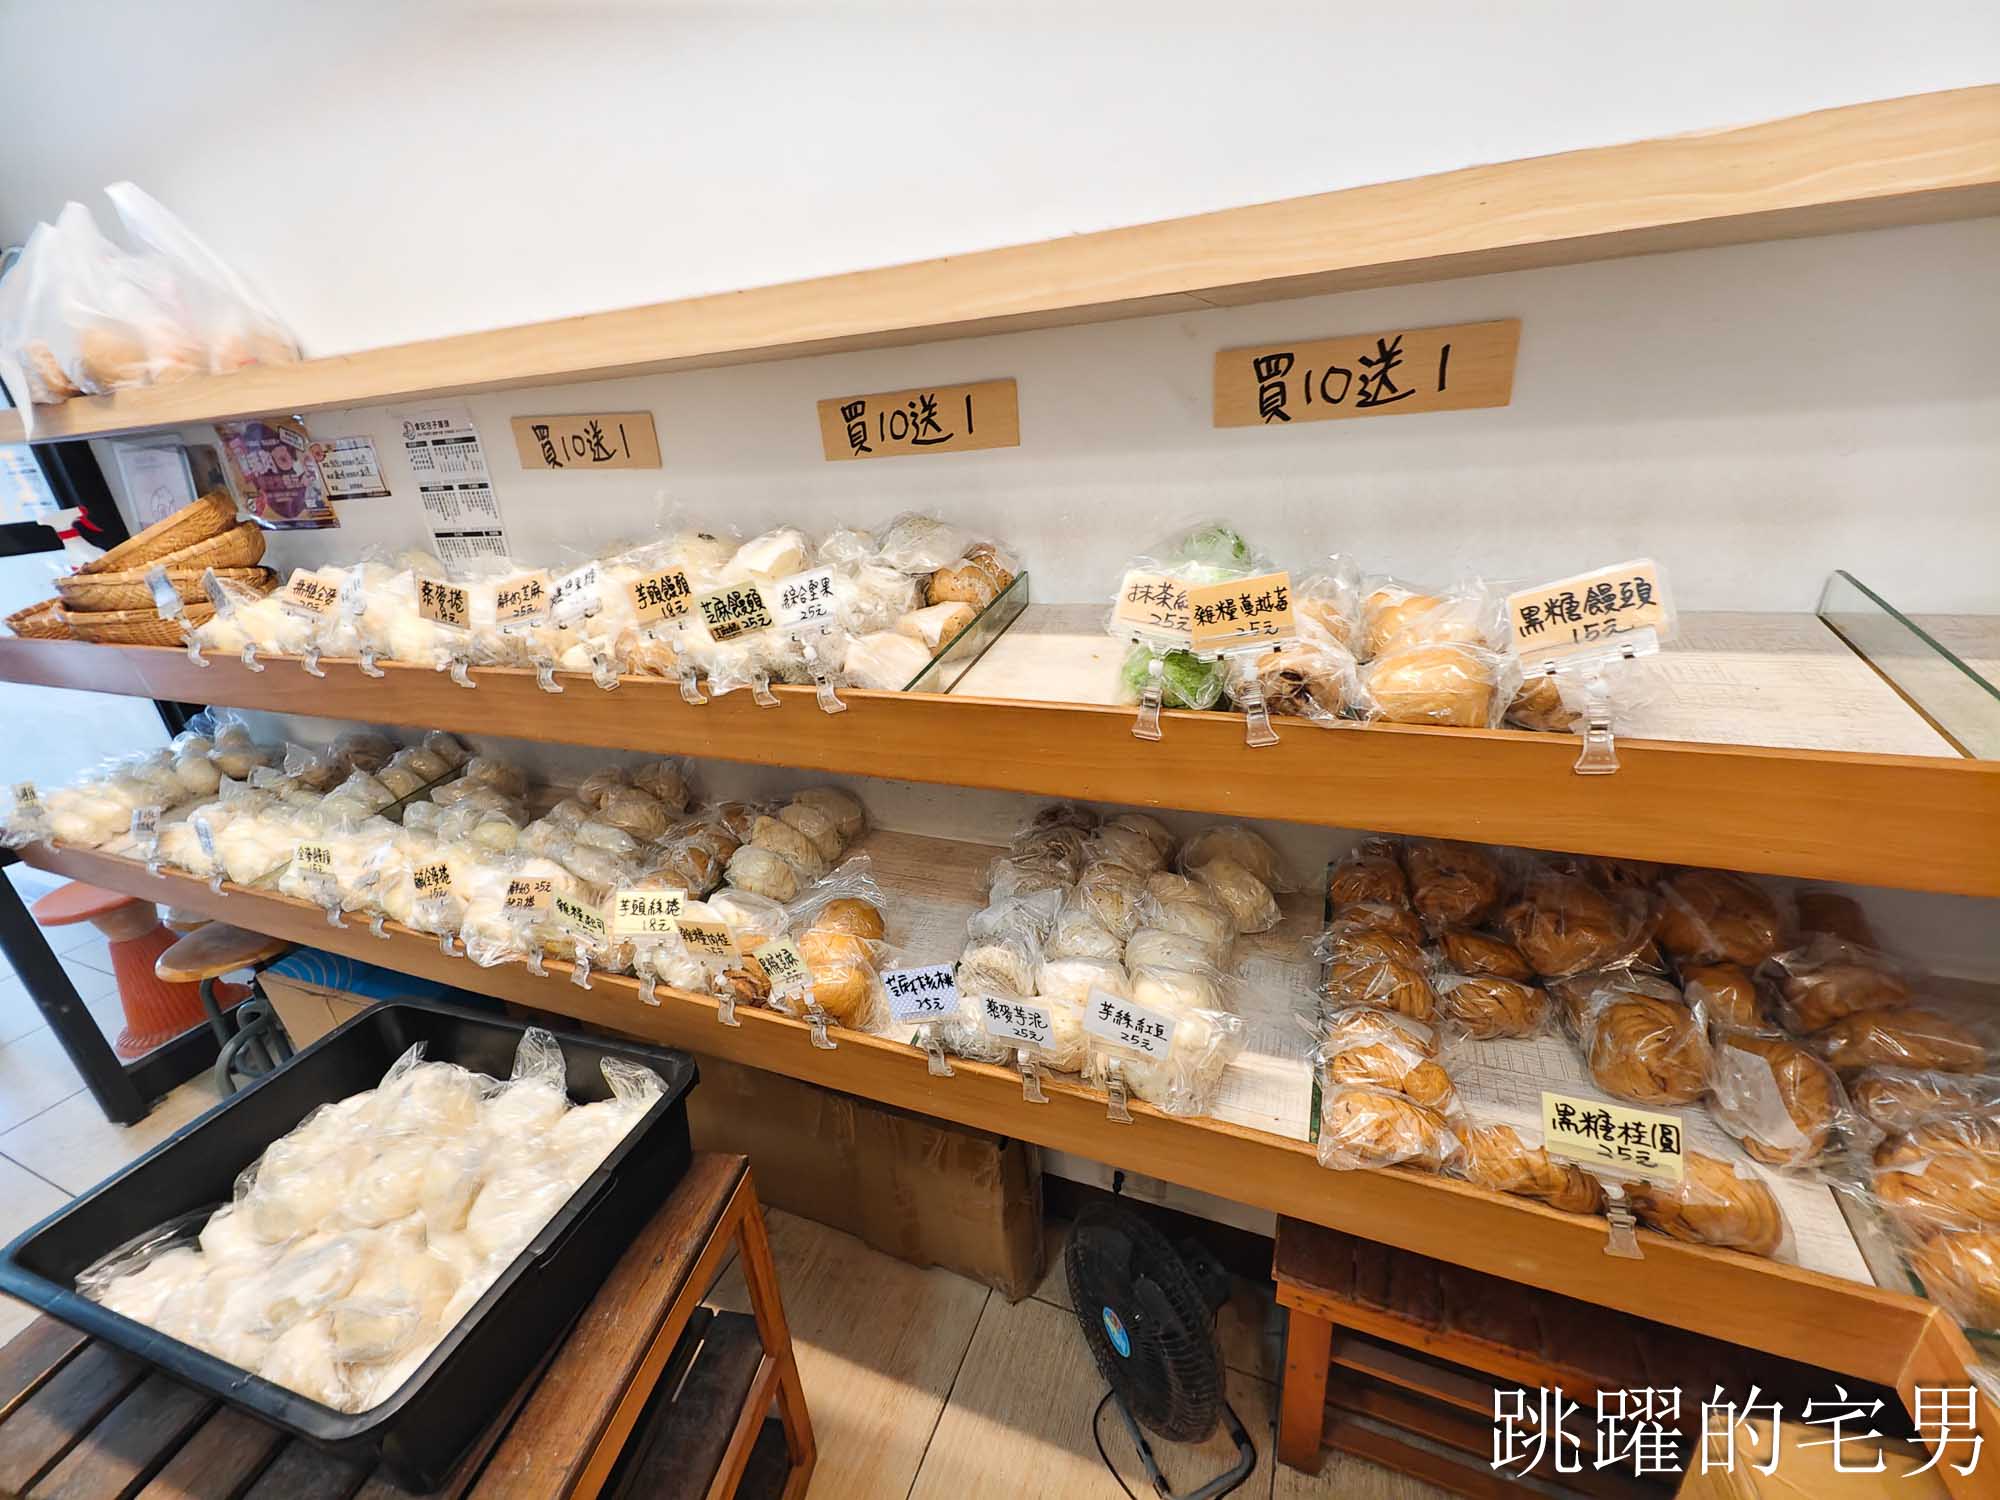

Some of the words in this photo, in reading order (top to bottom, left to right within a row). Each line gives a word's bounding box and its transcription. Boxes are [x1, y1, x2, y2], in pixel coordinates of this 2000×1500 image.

[1252, 334, 1452, 425] 買10送1
[841, 393, 975, 456] 買10送1
[532, 420, 630, 469] 買10送1
[635, 572, 692, 610] 芋頭饅頭
[700, 588, 767, 624] 芝麻饅頭
[783, 577, 834, 609] 綜合堅果
[660, 602, 690, 619] 18元
[743, 614, 773, 630] 25元
[800, 604, 828, 621] 25元
[1519, 577, 1657, 638] 黑糖饅頭
[1571, 618, 1635, 644] 15元
[884, 969, 955, 997] 芝麻核桃
[1012, 1027, 1046, 1042] 25元
[1120, 1031, 1155, 1052] 25元
[1551, 1102, 1681, 1155] 黑糖桂圓
[1597, 1143, 1660, 1169] 25元
